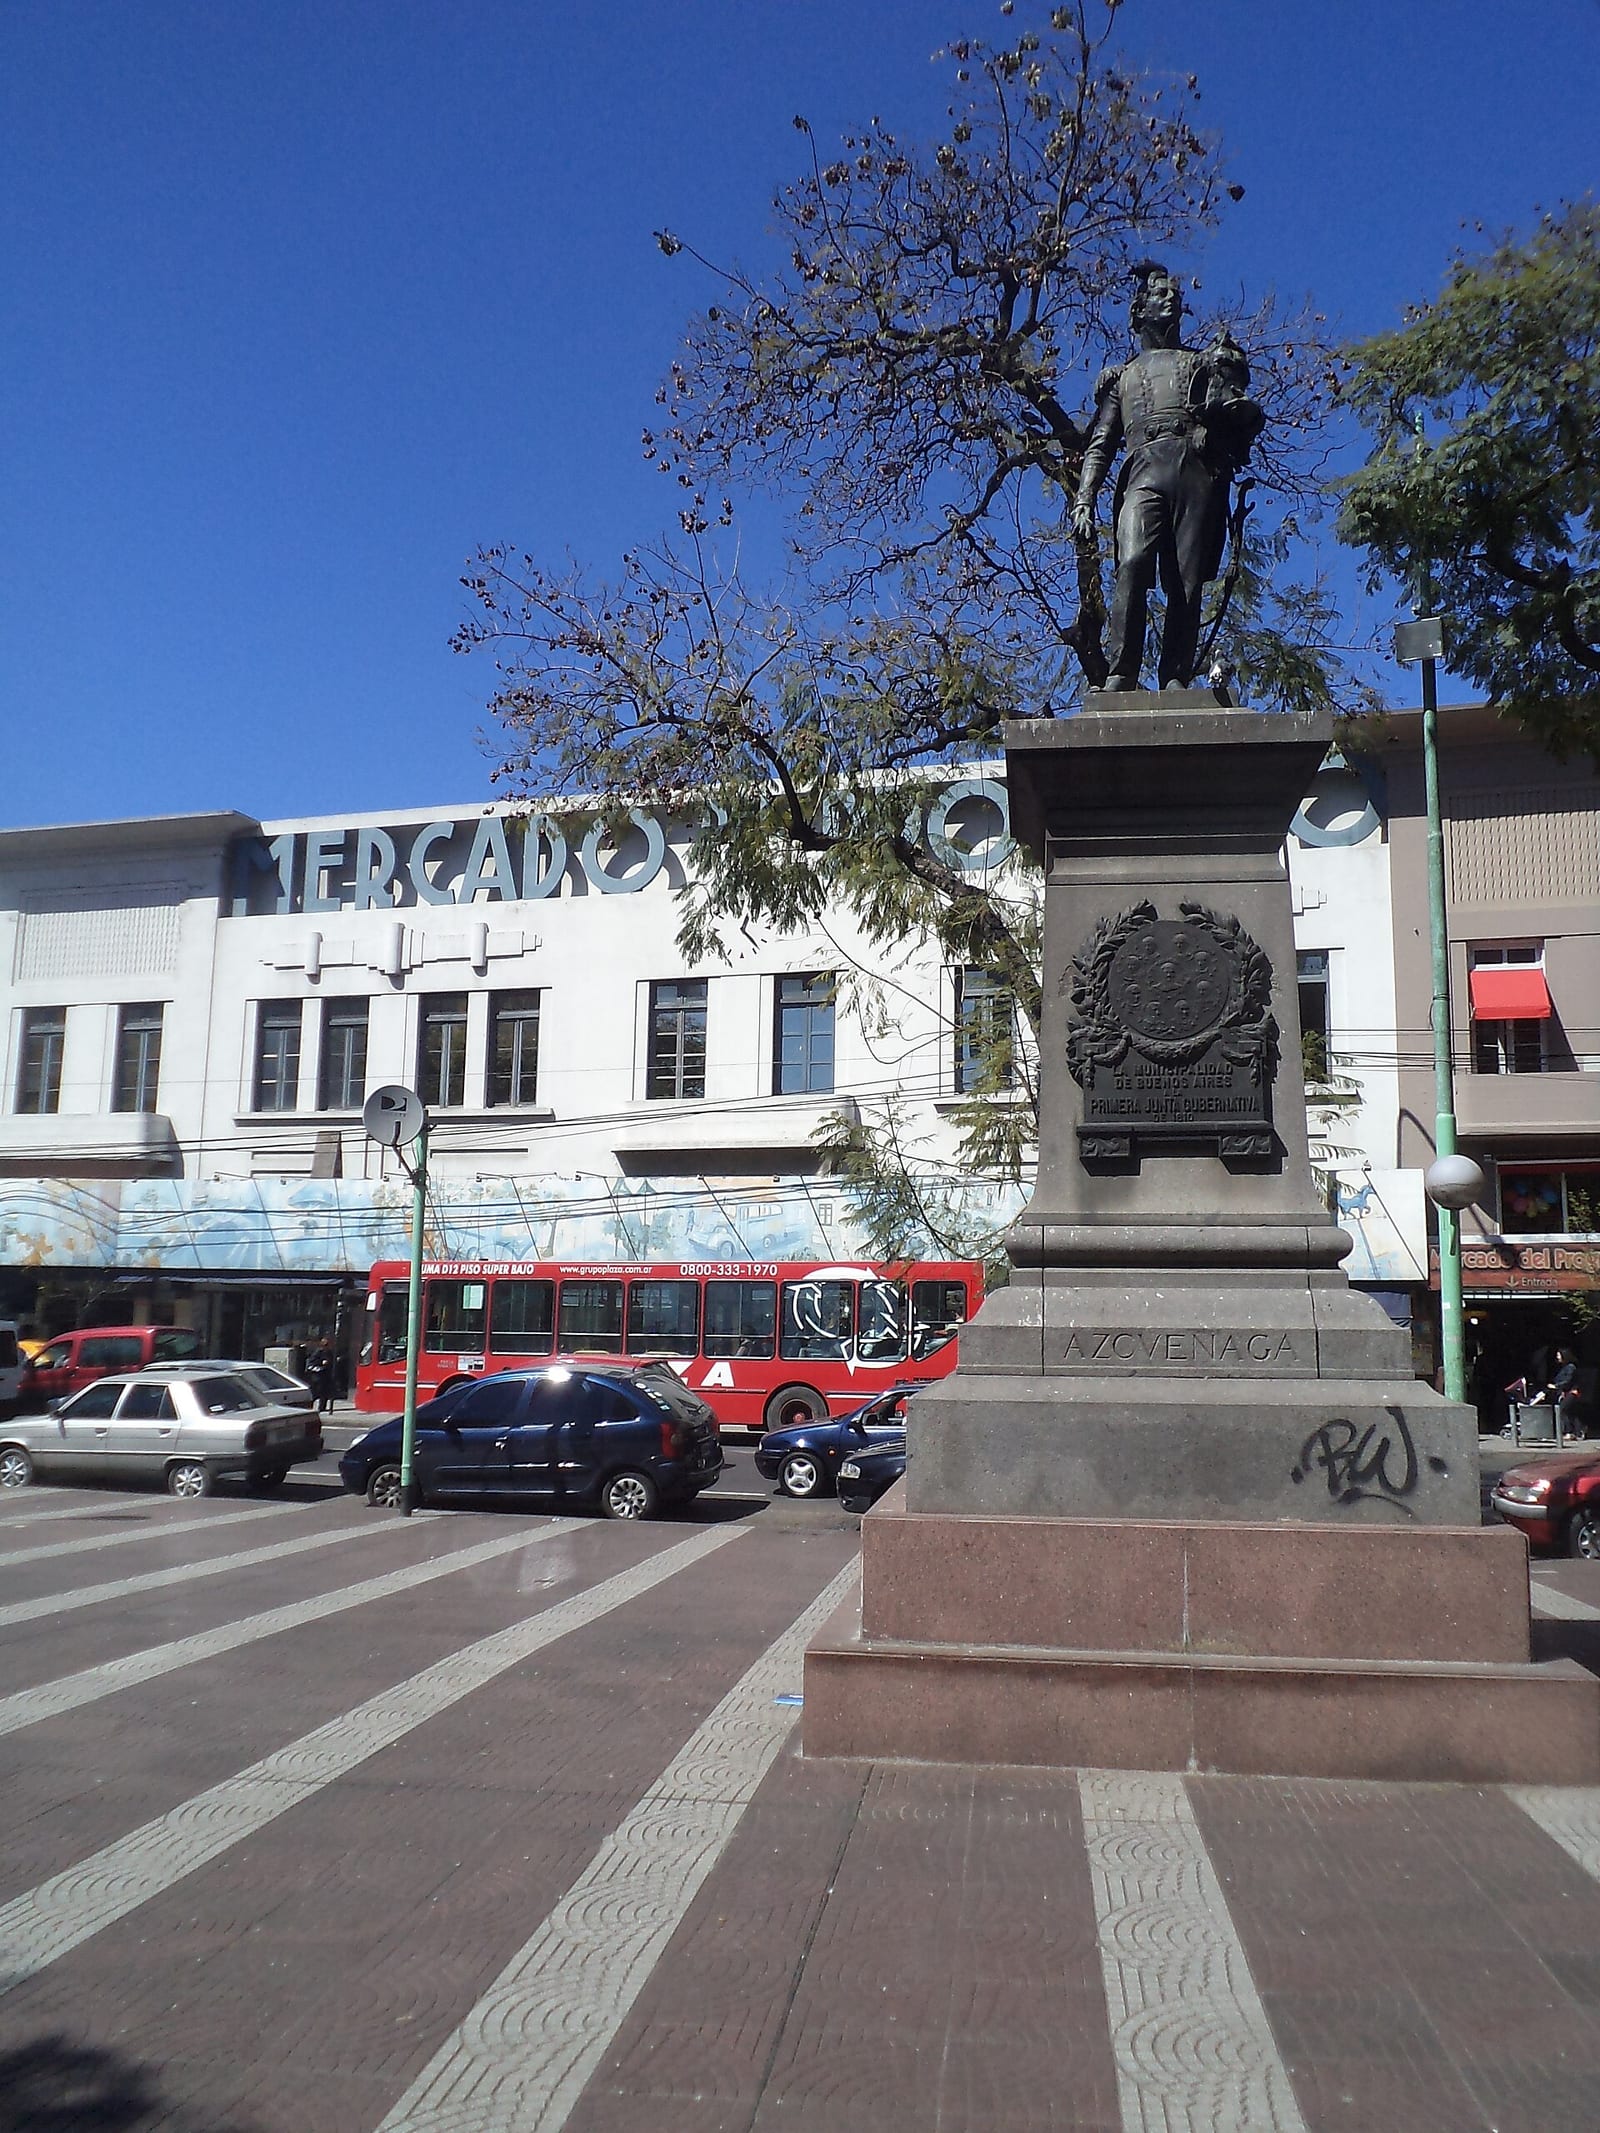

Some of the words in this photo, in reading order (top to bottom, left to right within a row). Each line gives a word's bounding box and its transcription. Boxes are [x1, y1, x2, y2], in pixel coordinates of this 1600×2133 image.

[232, 808, 665, 917] MERCADO
[1115, 1077, 1132, 1090] DE
[1137, 1076, 1189, 1089] BUENOS
[1193, 1075, 1232, 1088] AIRES
[1090, 1098, 1141, 1114] PRIMERA
[1144, 1098, 1179, 1113] JUNTA
[1183, 1096, 1260, 1113] GUBERNATIVA
[1520, 1247, 1551, 1270] del
[421, 1263, 440, 1275] UMA
[441, 1264, 459, 1275] D12
[460, 1264, 481, 1275] PISO
[482, 1264, 510, 1275] SUPER
[511, 1264, 534, 1275] BAJO
[559, 1265, 653, 1276] www.grupoplaza.com.ar
[680, 1264, 778, 1276] 0800-333-1970
[1521, 1277, 1558, 1287] Entrada
